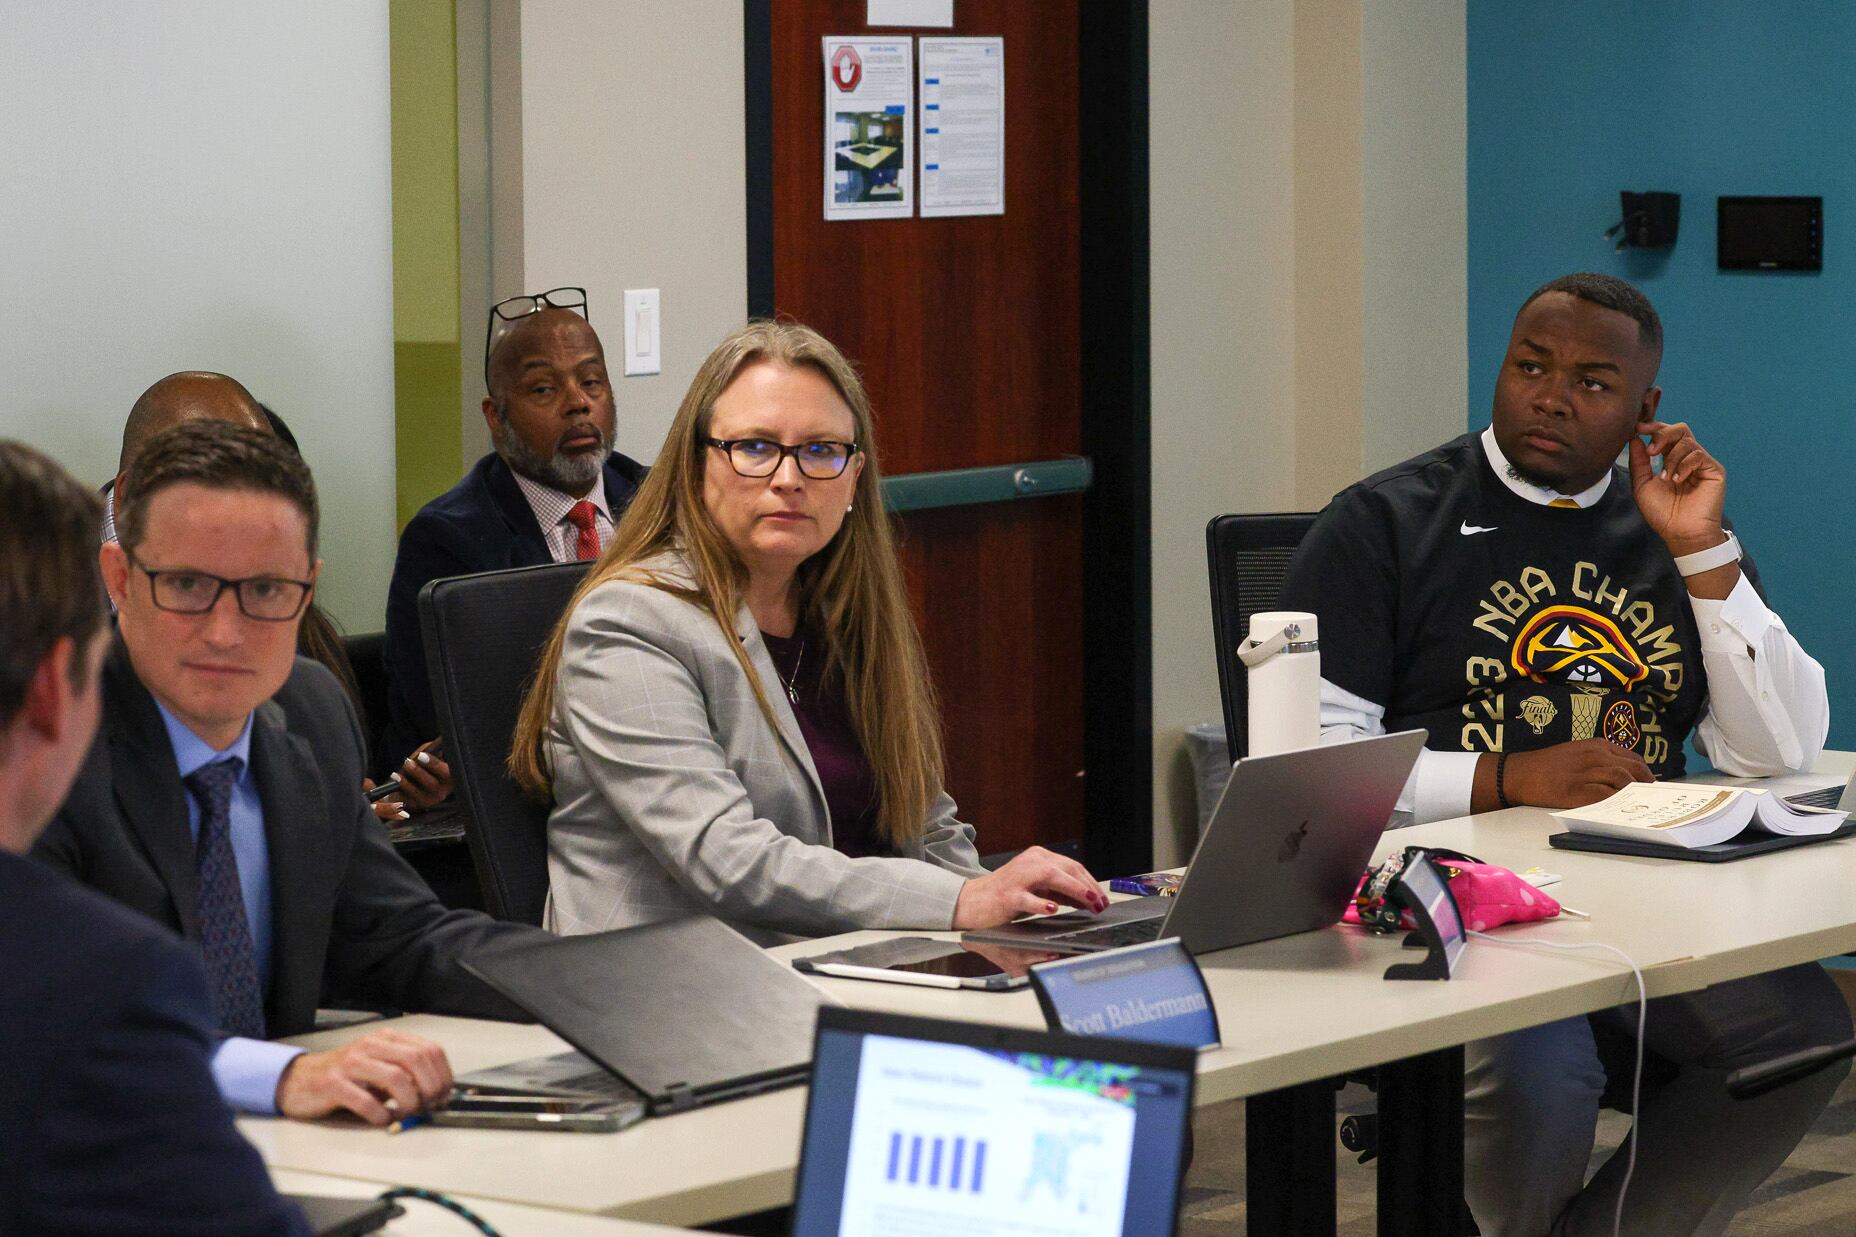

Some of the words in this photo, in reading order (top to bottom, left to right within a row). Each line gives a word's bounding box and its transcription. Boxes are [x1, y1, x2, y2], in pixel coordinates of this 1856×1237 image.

[1472, 565, 1557, 643] NBA
[1515, 698, 1559, 720] Finals
[1105, 992, 1208, 1030] Baldermann
